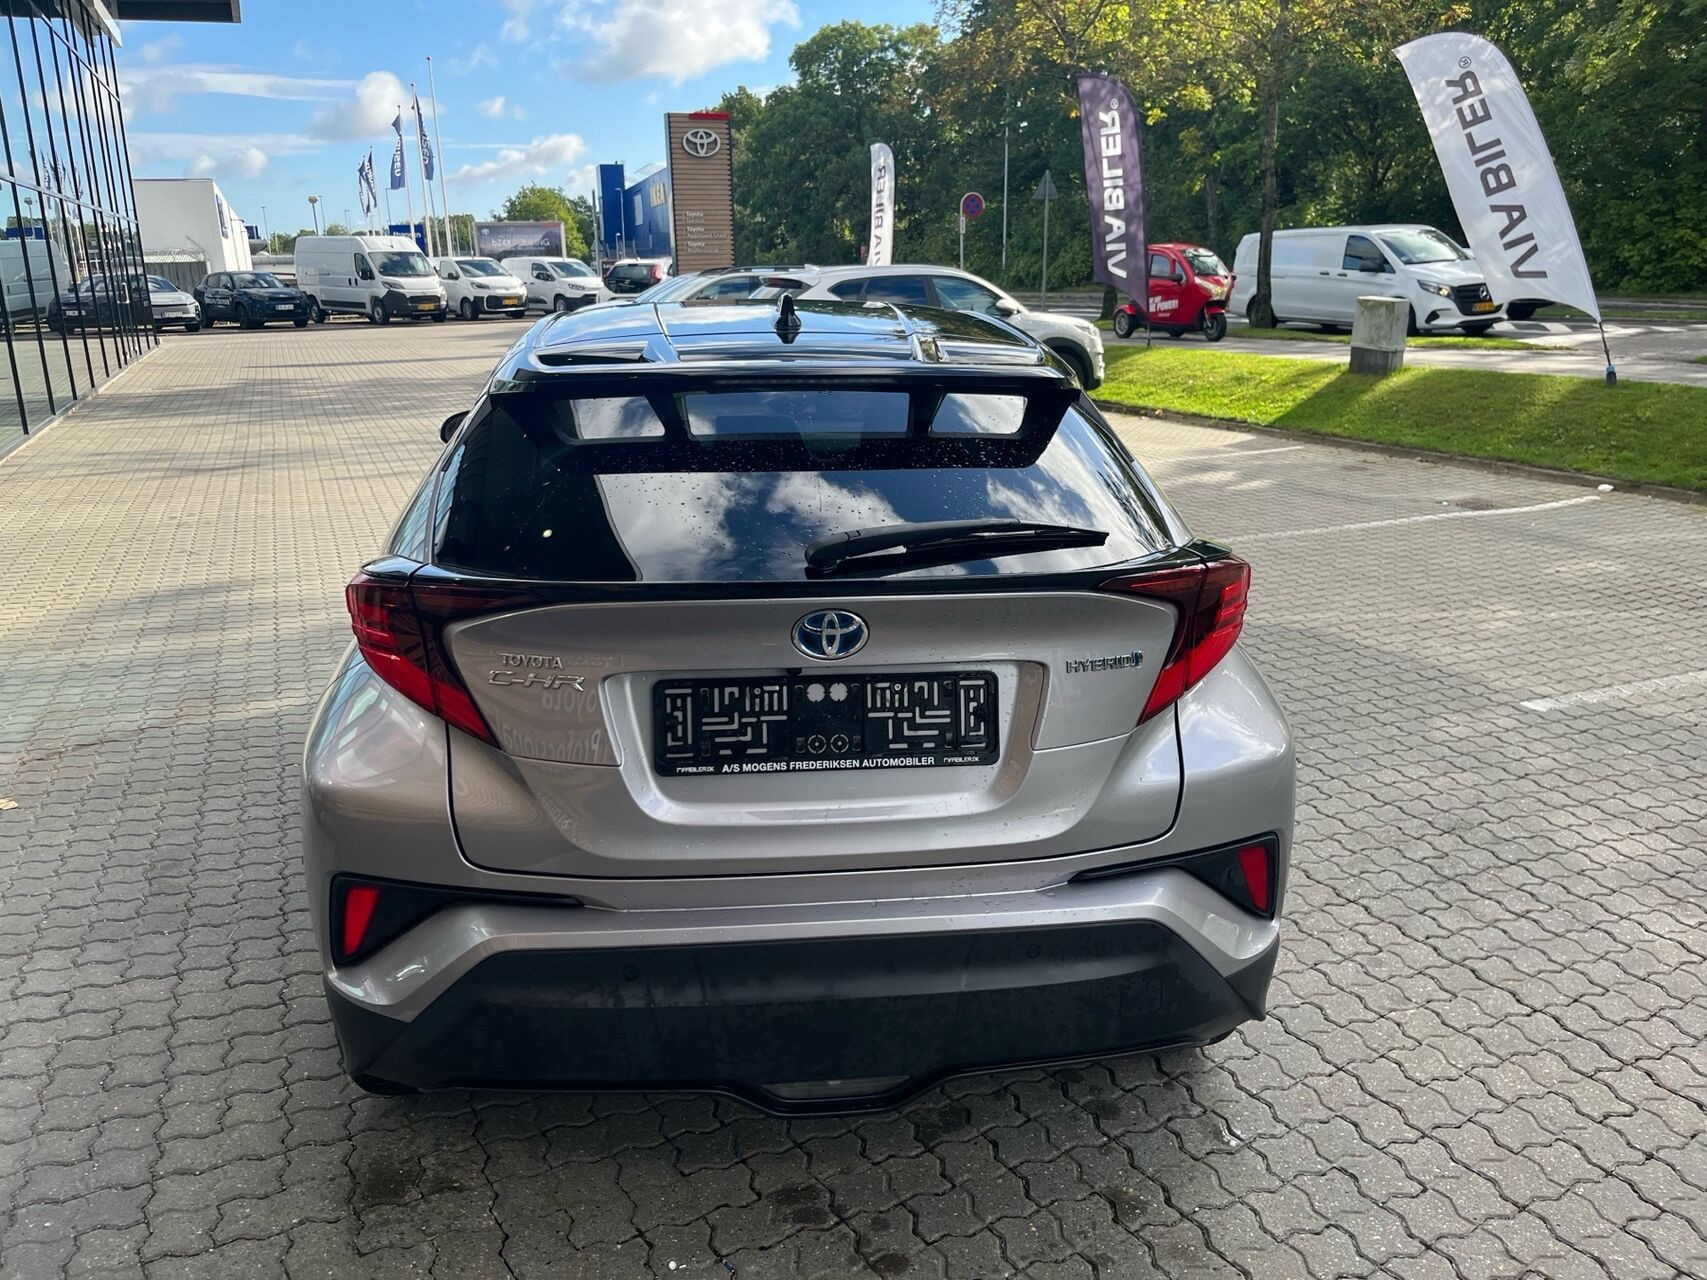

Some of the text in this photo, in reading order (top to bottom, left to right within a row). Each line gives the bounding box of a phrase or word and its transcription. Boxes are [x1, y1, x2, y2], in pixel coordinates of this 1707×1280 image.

[501, 652, 564, 670] TOYOTA
[1066, 655, 1132, 673] HYBRID
[487, 670, 585, 692] C-HR
[722, 757, 935, 773] A/S MOGENS FREDERIKSEN AUTOMOBILER
